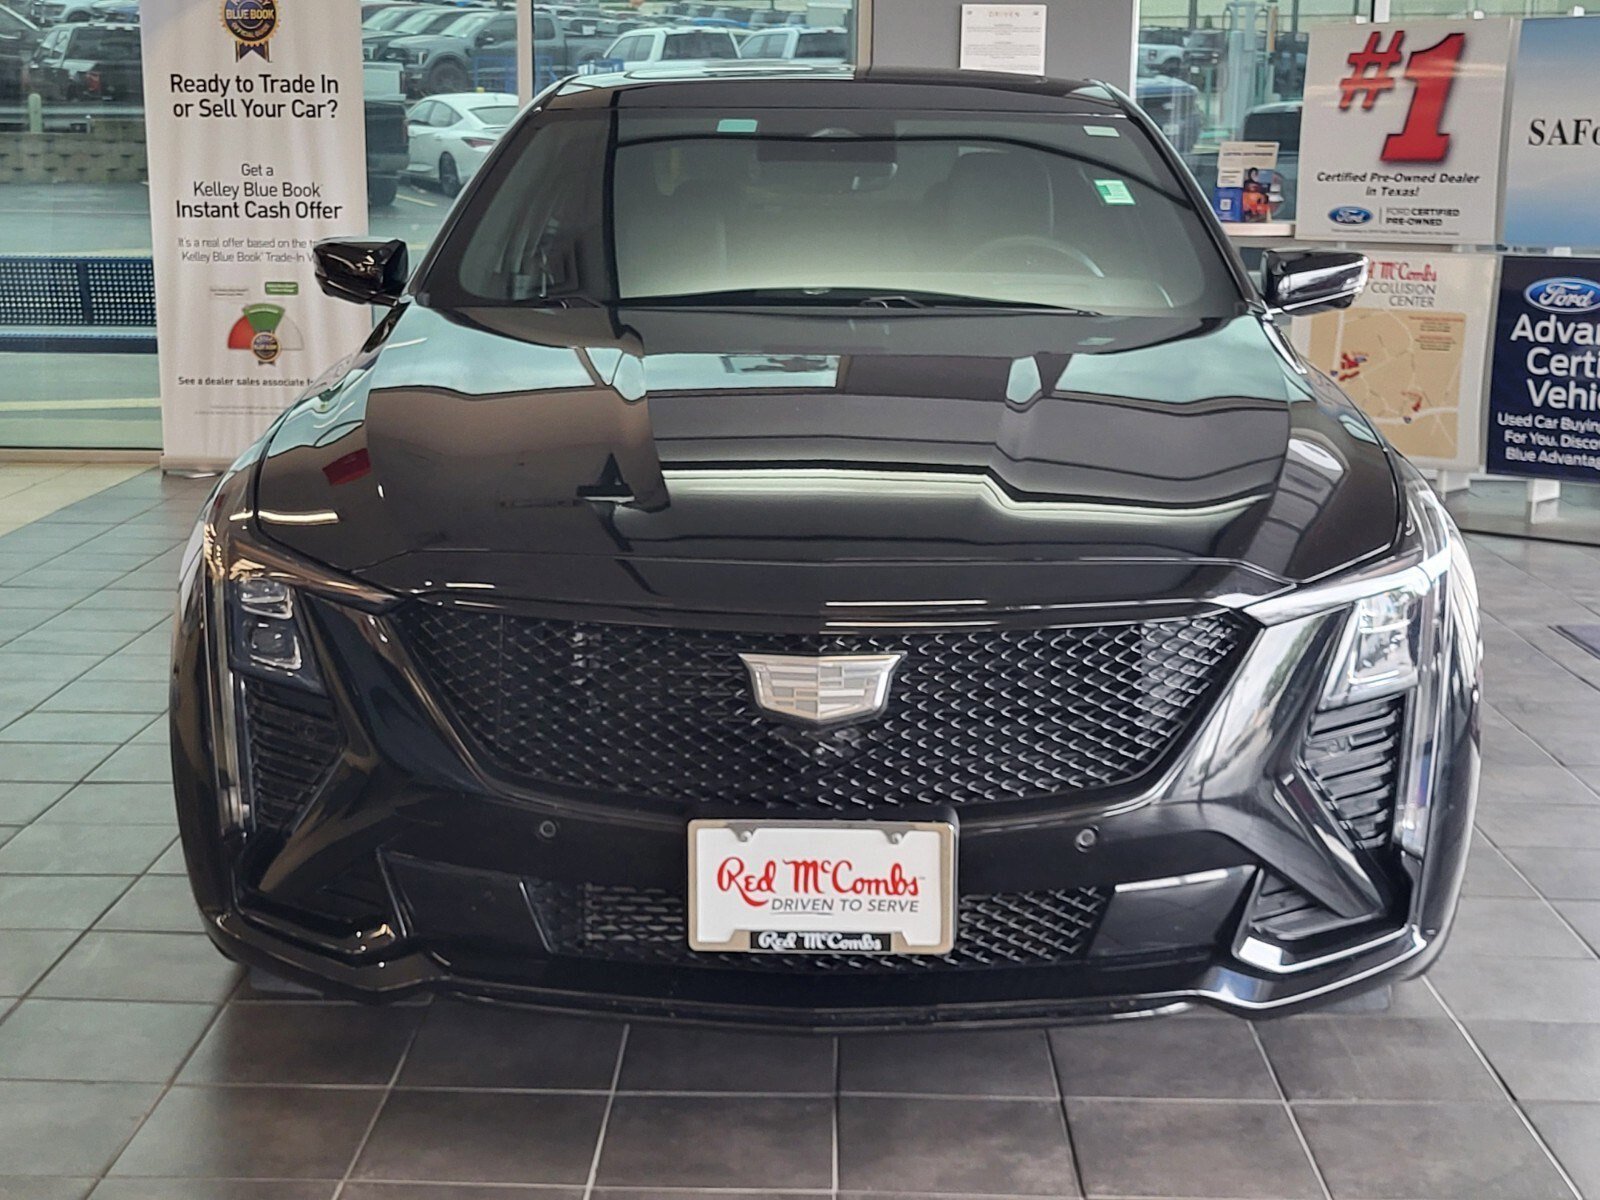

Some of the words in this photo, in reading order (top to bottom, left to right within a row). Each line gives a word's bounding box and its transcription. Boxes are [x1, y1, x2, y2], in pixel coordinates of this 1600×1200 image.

[226, 9, 250, 20] BLUE
[250, 9, 274, 20] BOOK
[170, 74, 230, 97] Ready
[236, 75, 254, 93] to
[258, 74, 314, 93] Trade
[322, 75, 338, 93] In
[1338, 29, 1466, 162] #1
[173, 103, 194, 118] or
[199, 99, 237, 118] Sell
[242, 100, 286, 118] Your
[292, 100, 338, 118] Car?
[241, 164, 262, 176] Get
[266, 166, 274, 176] a
[1317, 172, 1366, 182] Certified
[1370, 173, 1435, 183] Pre-Owned
[1440, 173, 1480, 184] Dealer
[194, 182, 239, 200] Kelley
[244, 182, 278, 197] Blue
[283, 182, 321, 198] Book
[1366, 186, 1376, 196] in
[1382, 187, 1420, 196] Texas!
[176, 200, 240, 218] Instant
[245, 201, 290, 218] Cash
[296, 202, 342, 219] Offer
[1386, 208, 1410, 216] FORD
[1412, 208, 1460, 217] CERTIFIED
[1386, 217, 1442, 226] PRE-OWNED
[178, 238, 192, 248] It's
[194, 240, 200, 248] a
[202, 238, 219, 248] real
[222, 238, 244, 248] offer
[247, 238, 275, 248] based
[278, 240, 290, 248] on
[292, 239, 306, 248] the
[182, 252, 210, 263] Kelley
[213, 252, 234, 262] Blue
[238, 252, 261, 262] Book
[266, 252, 304, 262] Trade-In
[1370, 282, 1436, 295] COLLISION
[1540, 283, 1594, 307] Ford
[1389, 295, 1434, 307] CENTER
[1510, 314, 1600, 346] Adva
[178, 376, 195, 386] See
[206, 377, 233, 386] dealer
[237, 378, 260, 386] sales
[262, 378, 304, 386] associate
[1526, 378, 1600, 411] Vehi
[1498, 412, 1532, 427] Used
[1534, 415, 1559, 429] Car
[1504, 430, 1528, 444] For
[1529, 432, 1558, 446] You.
[1561, 434, 1600, 450] Disco
[1506, 446, 1536, 462] Blue
[717, 857, 776, 907] Red
[782, 860, 919, 896] McCombs
[771, 898, 834, 912] DRIVEN
[841, 899, 861, 912] TO
[868, 900, 919, 913] SERVE
[758, 932, 797, 951] Red
[798, 932, 882, 951] McCombs
